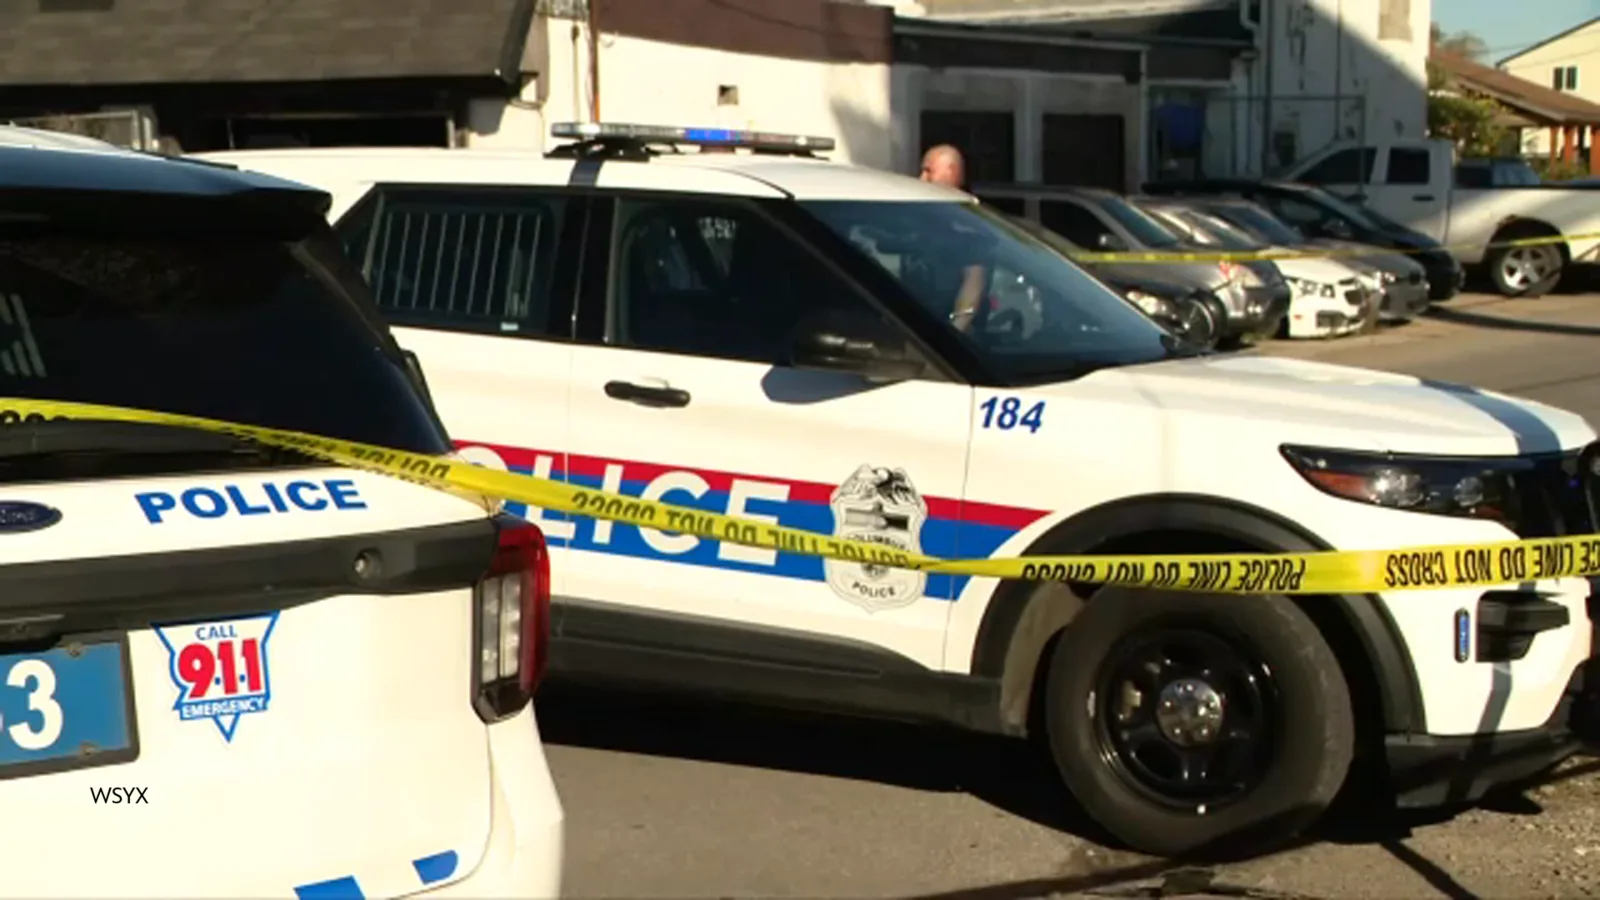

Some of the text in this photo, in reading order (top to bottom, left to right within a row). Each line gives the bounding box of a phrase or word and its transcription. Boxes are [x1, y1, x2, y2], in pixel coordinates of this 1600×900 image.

[980, 396, 1046, 434] 184
[135, 478, 367, 524] POLICE
[455, 446, 790, 566] LICE
[1151, 561, 1181, 585] DO
[1185, 561, 1231, 591] LINE
[1233, 557, 1306, 592] POLICE
[1384, 551, 1447, 587] CROSS
[1455, 549, 1492, 583] NOT
[1499, 547, 1526, 580] DO
[1532, 544, 1574, 578] LINE
[852, 582, 895, 598] POLICE
[195, 624, 238, 641] CALL
[0, 659, 63, 750] 3
[182, 698, 264, 717] EMERGENCY
